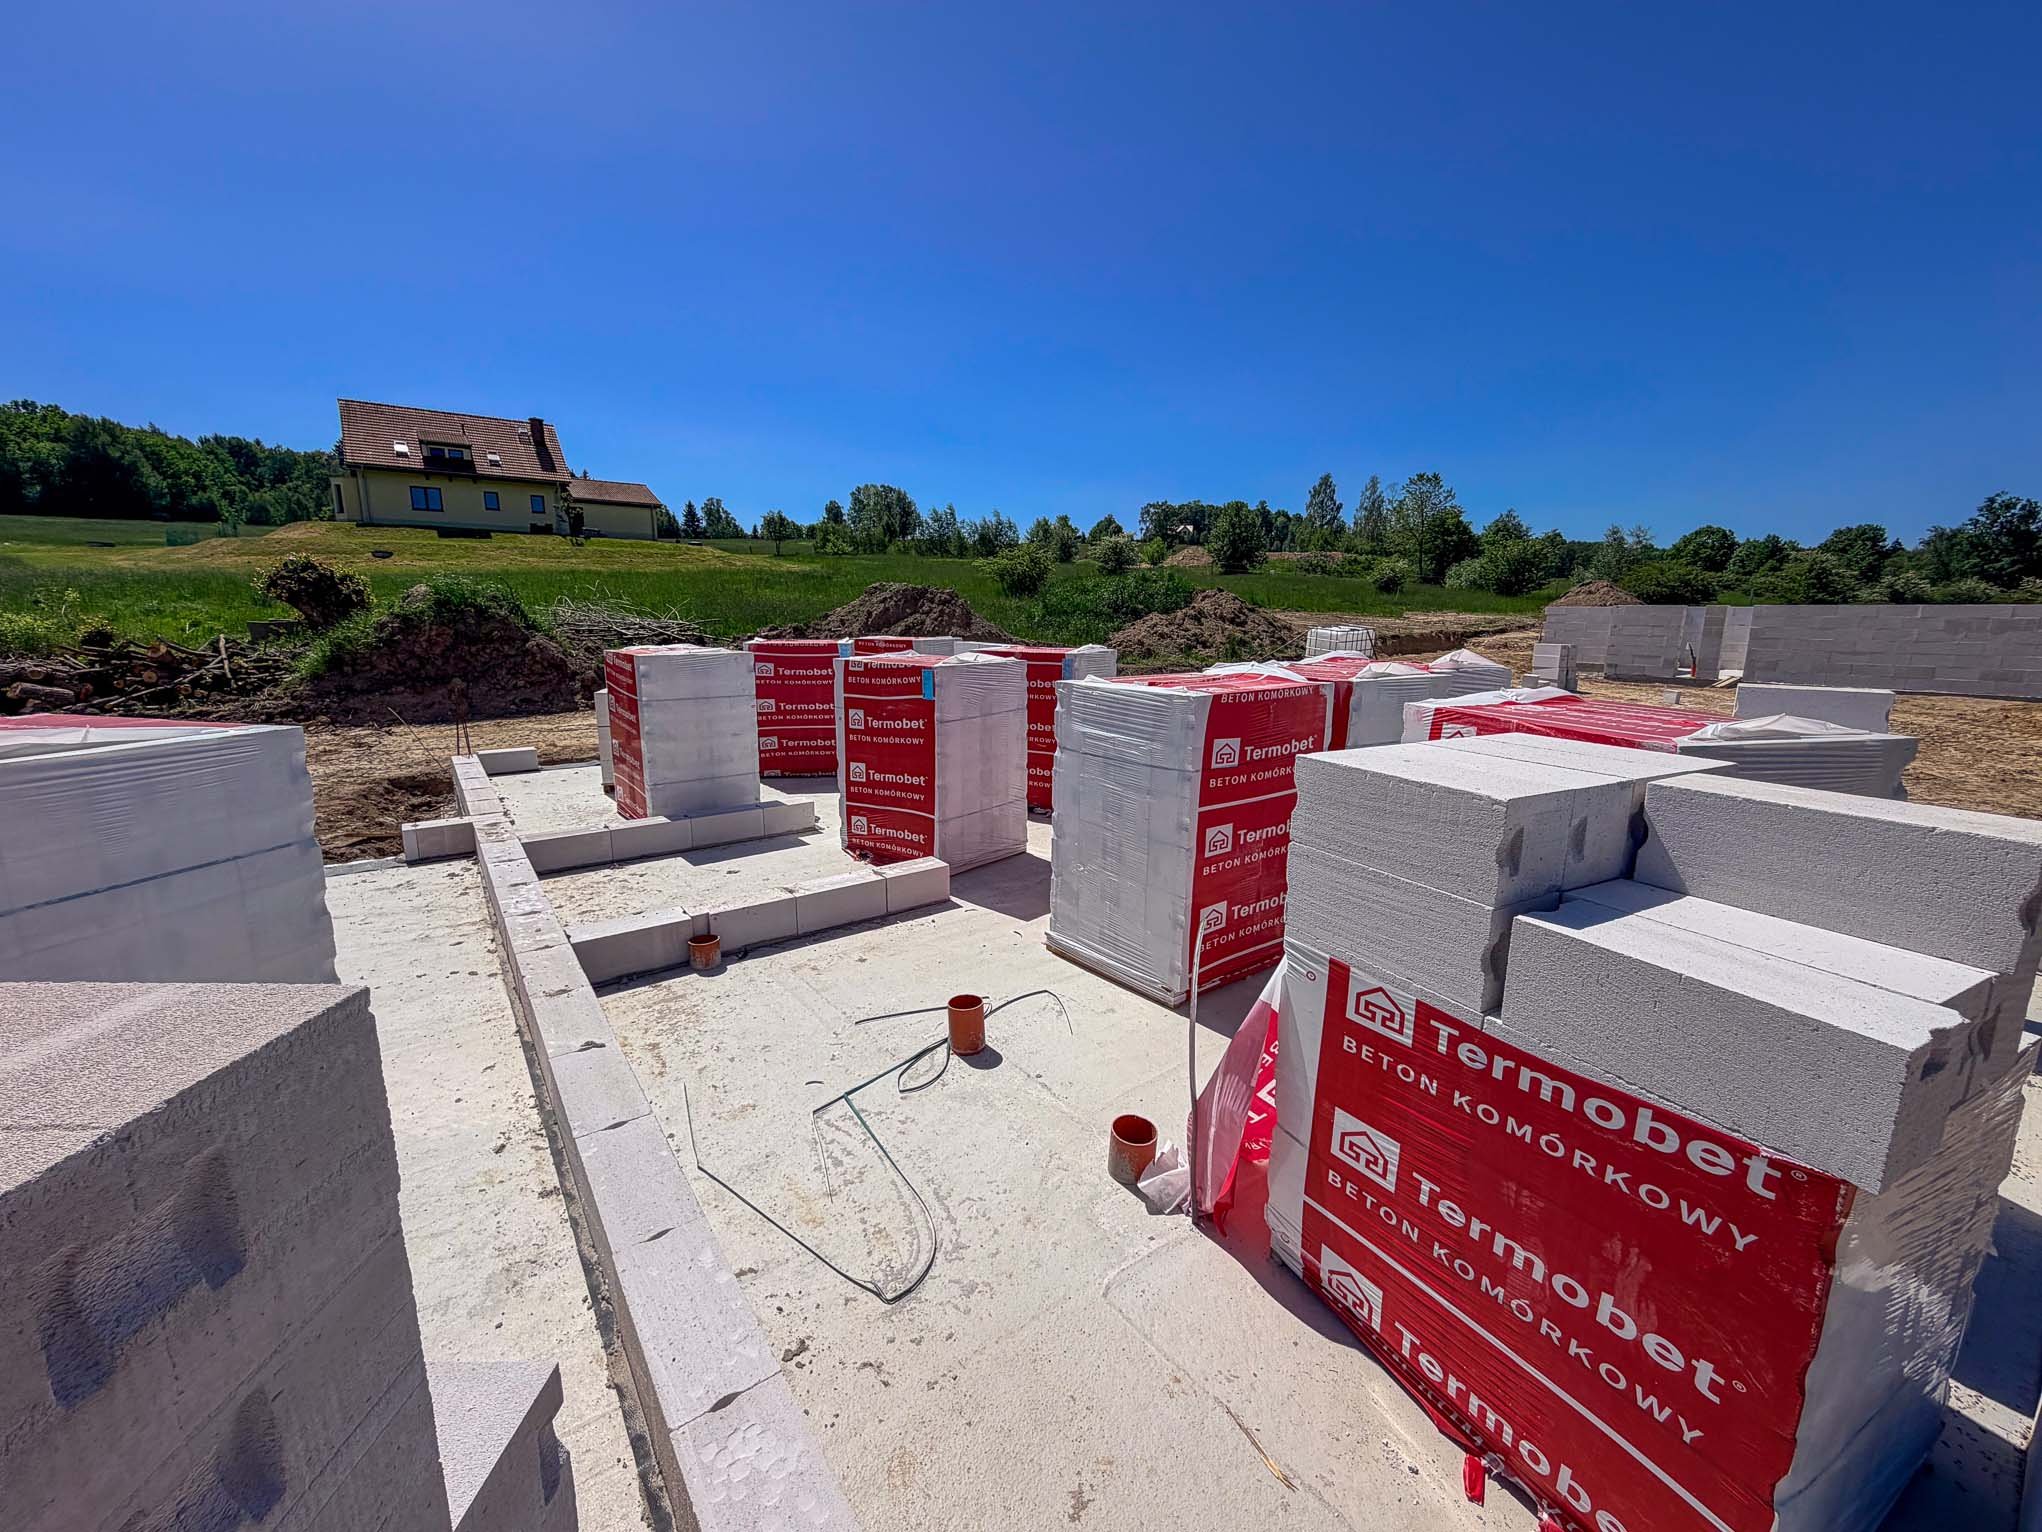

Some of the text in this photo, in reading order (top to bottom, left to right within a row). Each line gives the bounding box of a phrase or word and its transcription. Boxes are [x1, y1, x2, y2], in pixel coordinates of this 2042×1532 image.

[777, 667, 833, 676] Termobet
[848, 676, 921, 685] BETON KOMÓRKOWY
[1221, 692, 1255, 703] BETON
[778, 702, 836, 710] Termobet
[866, 716, 926, 729] Termobet
[780, 739, 836, 747] Termobet
[849, 734, 924, 744] BETON KOMÓRKOWY
[1244, 735, 1315, 761] Termobet
[868, 770, 927, 786] Termobet
[1209, 775, 1247, 788] BETON
[850, 786, 925, 800] BETON KOMÓRKOWY
[869, 823, 926, 844] Termobet
[876, 842, 924, 857] KOMÓRKOWY
[1203, 857, 1241, 876] BETON
[1342, 1034, 1438, 1096] BETON
[1452, 1089, 1759, 1252] KOMÓRKOWY
[1327, 1169, 1420, 1243] BETON
[1432, 1241, 1705, 1445] KOMÓRKOWY
